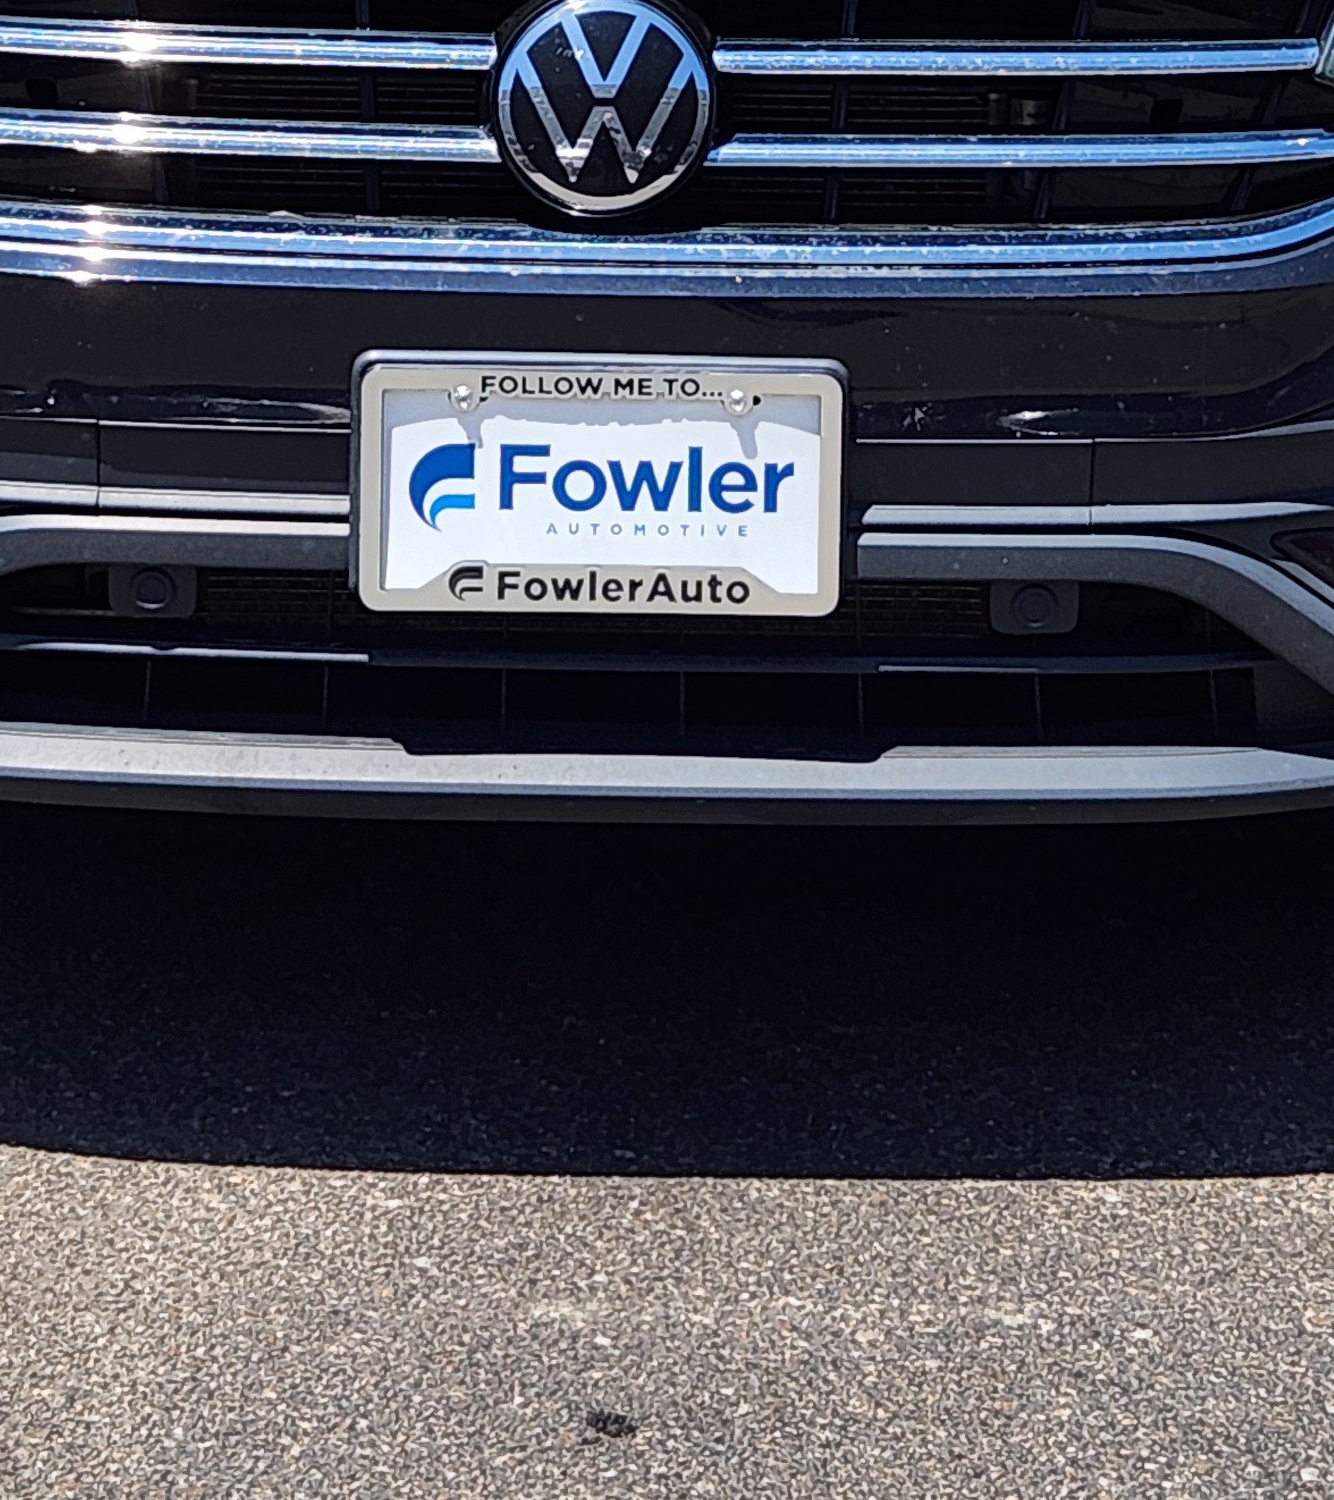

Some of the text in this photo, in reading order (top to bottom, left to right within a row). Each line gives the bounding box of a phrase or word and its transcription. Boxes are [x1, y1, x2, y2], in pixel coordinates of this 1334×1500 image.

[480, 375, 603, 396] FOLLOW
[613, 378, 653, 397] ME
[498, 443, 795, 513] Fowler
[546, 522, 749, 537] AUTOMOTIVE
[496, 569, 752, 605] FowlerAuto
